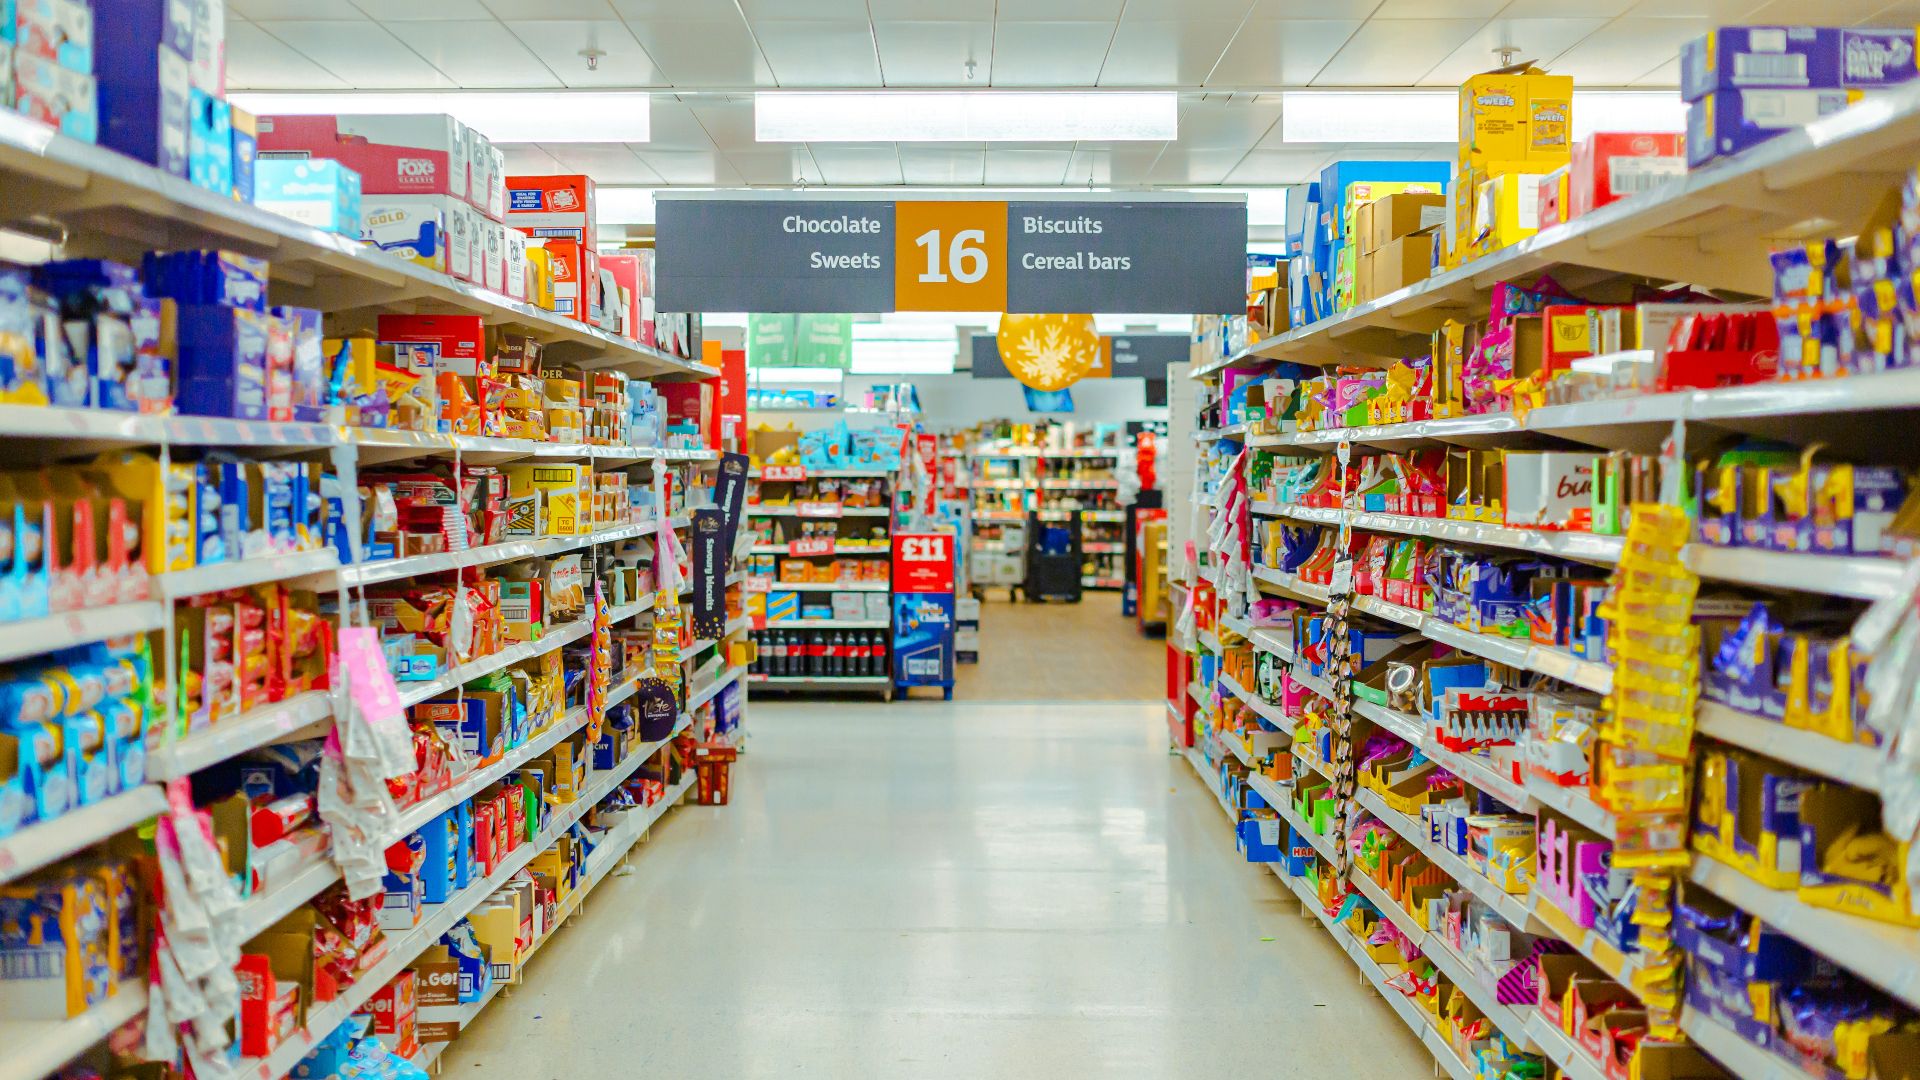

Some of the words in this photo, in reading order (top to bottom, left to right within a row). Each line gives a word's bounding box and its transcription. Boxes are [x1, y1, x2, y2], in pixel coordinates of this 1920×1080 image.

[369, 212, 404, 225] GOLD
[783, 215, 881, 234] Chocolate
[1023, 216, 1103, 234] Biscuits
[393, 248, 415, 258] OLD
[810, 252, 881, 270] Sweets
[915, 229, 989, 284] 16
[1022, 252, 1083, 270] Cereal
[1088, 252, 1131, 270] bars
[541, 369, 563, 379] DER
[705, 538, 715, 575] Savoury
[901, 537, 947, 561] £11
[705, 576, 715, 611] biscuits
[1292, 846, 1316, 858] HAR
